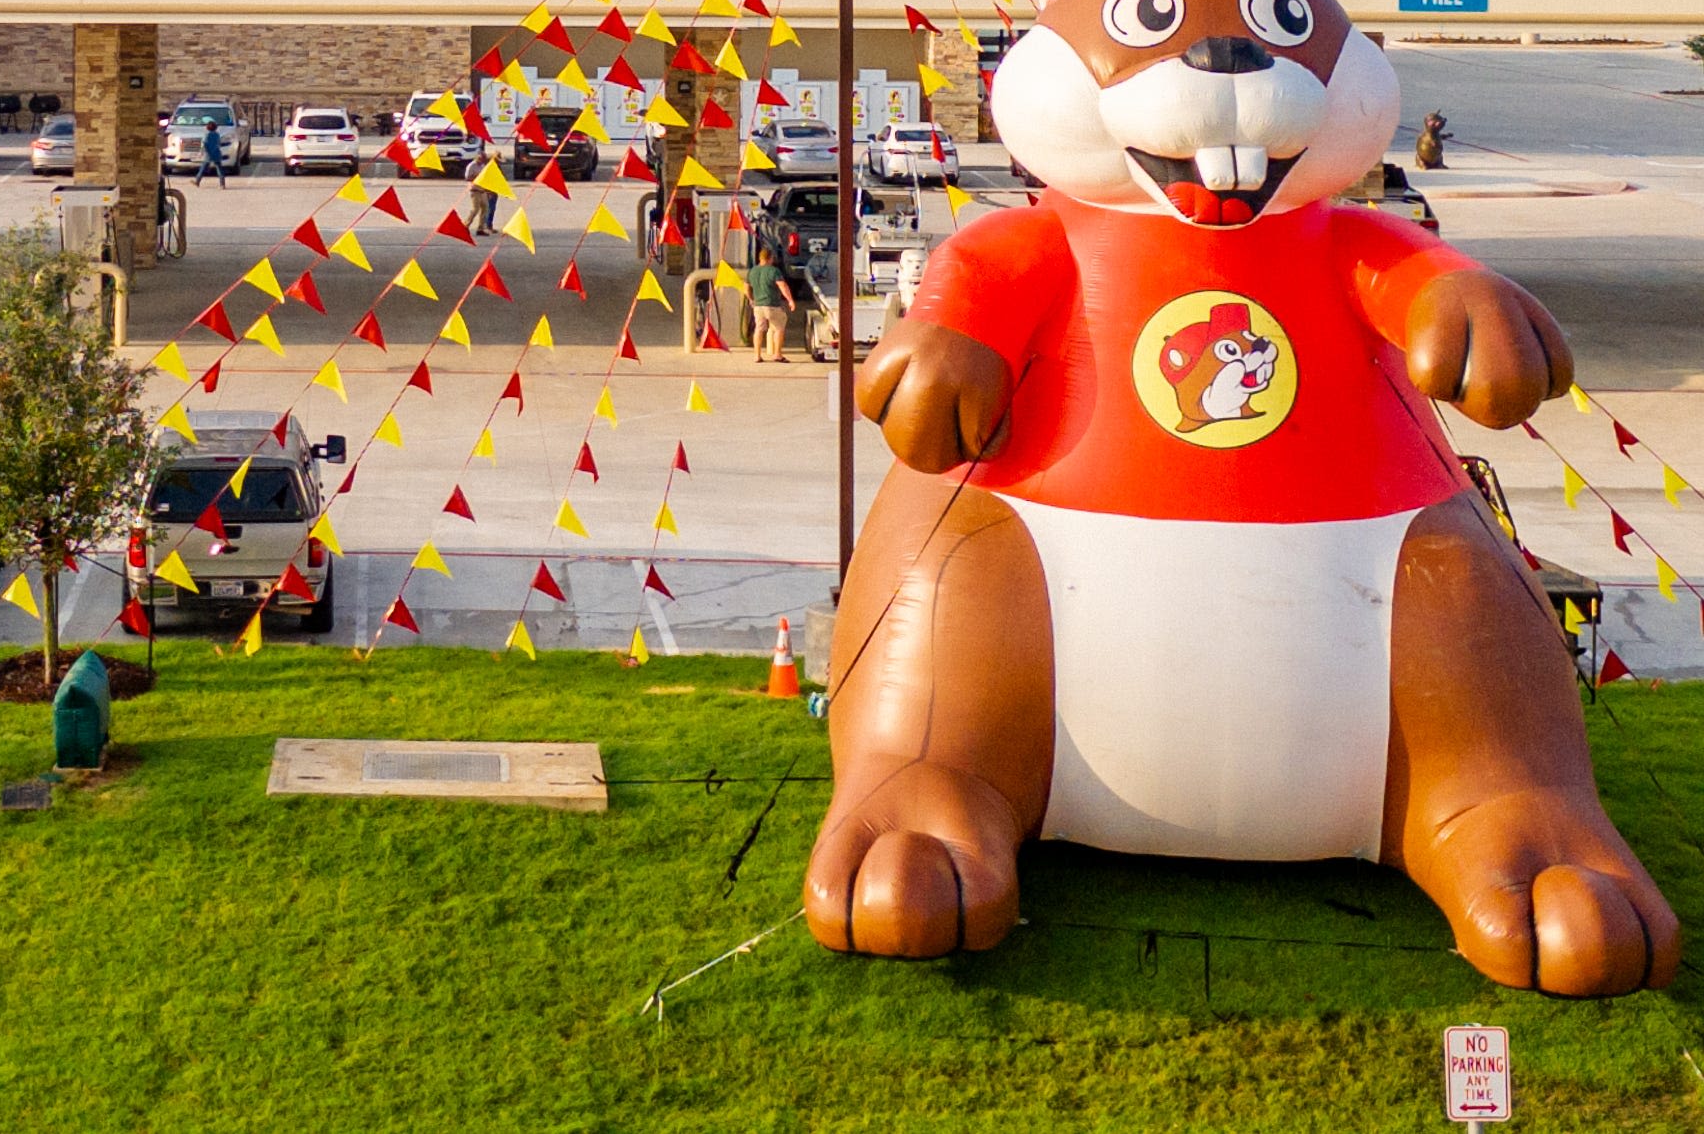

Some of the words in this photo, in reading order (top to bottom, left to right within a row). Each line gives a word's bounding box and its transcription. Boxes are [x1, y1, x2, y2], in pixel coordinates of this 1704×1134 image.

[1466, 1035, 1488, 1053] NO
[1451, 1056, 1504, 1074] PARKING
[1467, 1075, 1490, 1086] ANY
[1465, 1089, 1494, 1101] TIME
